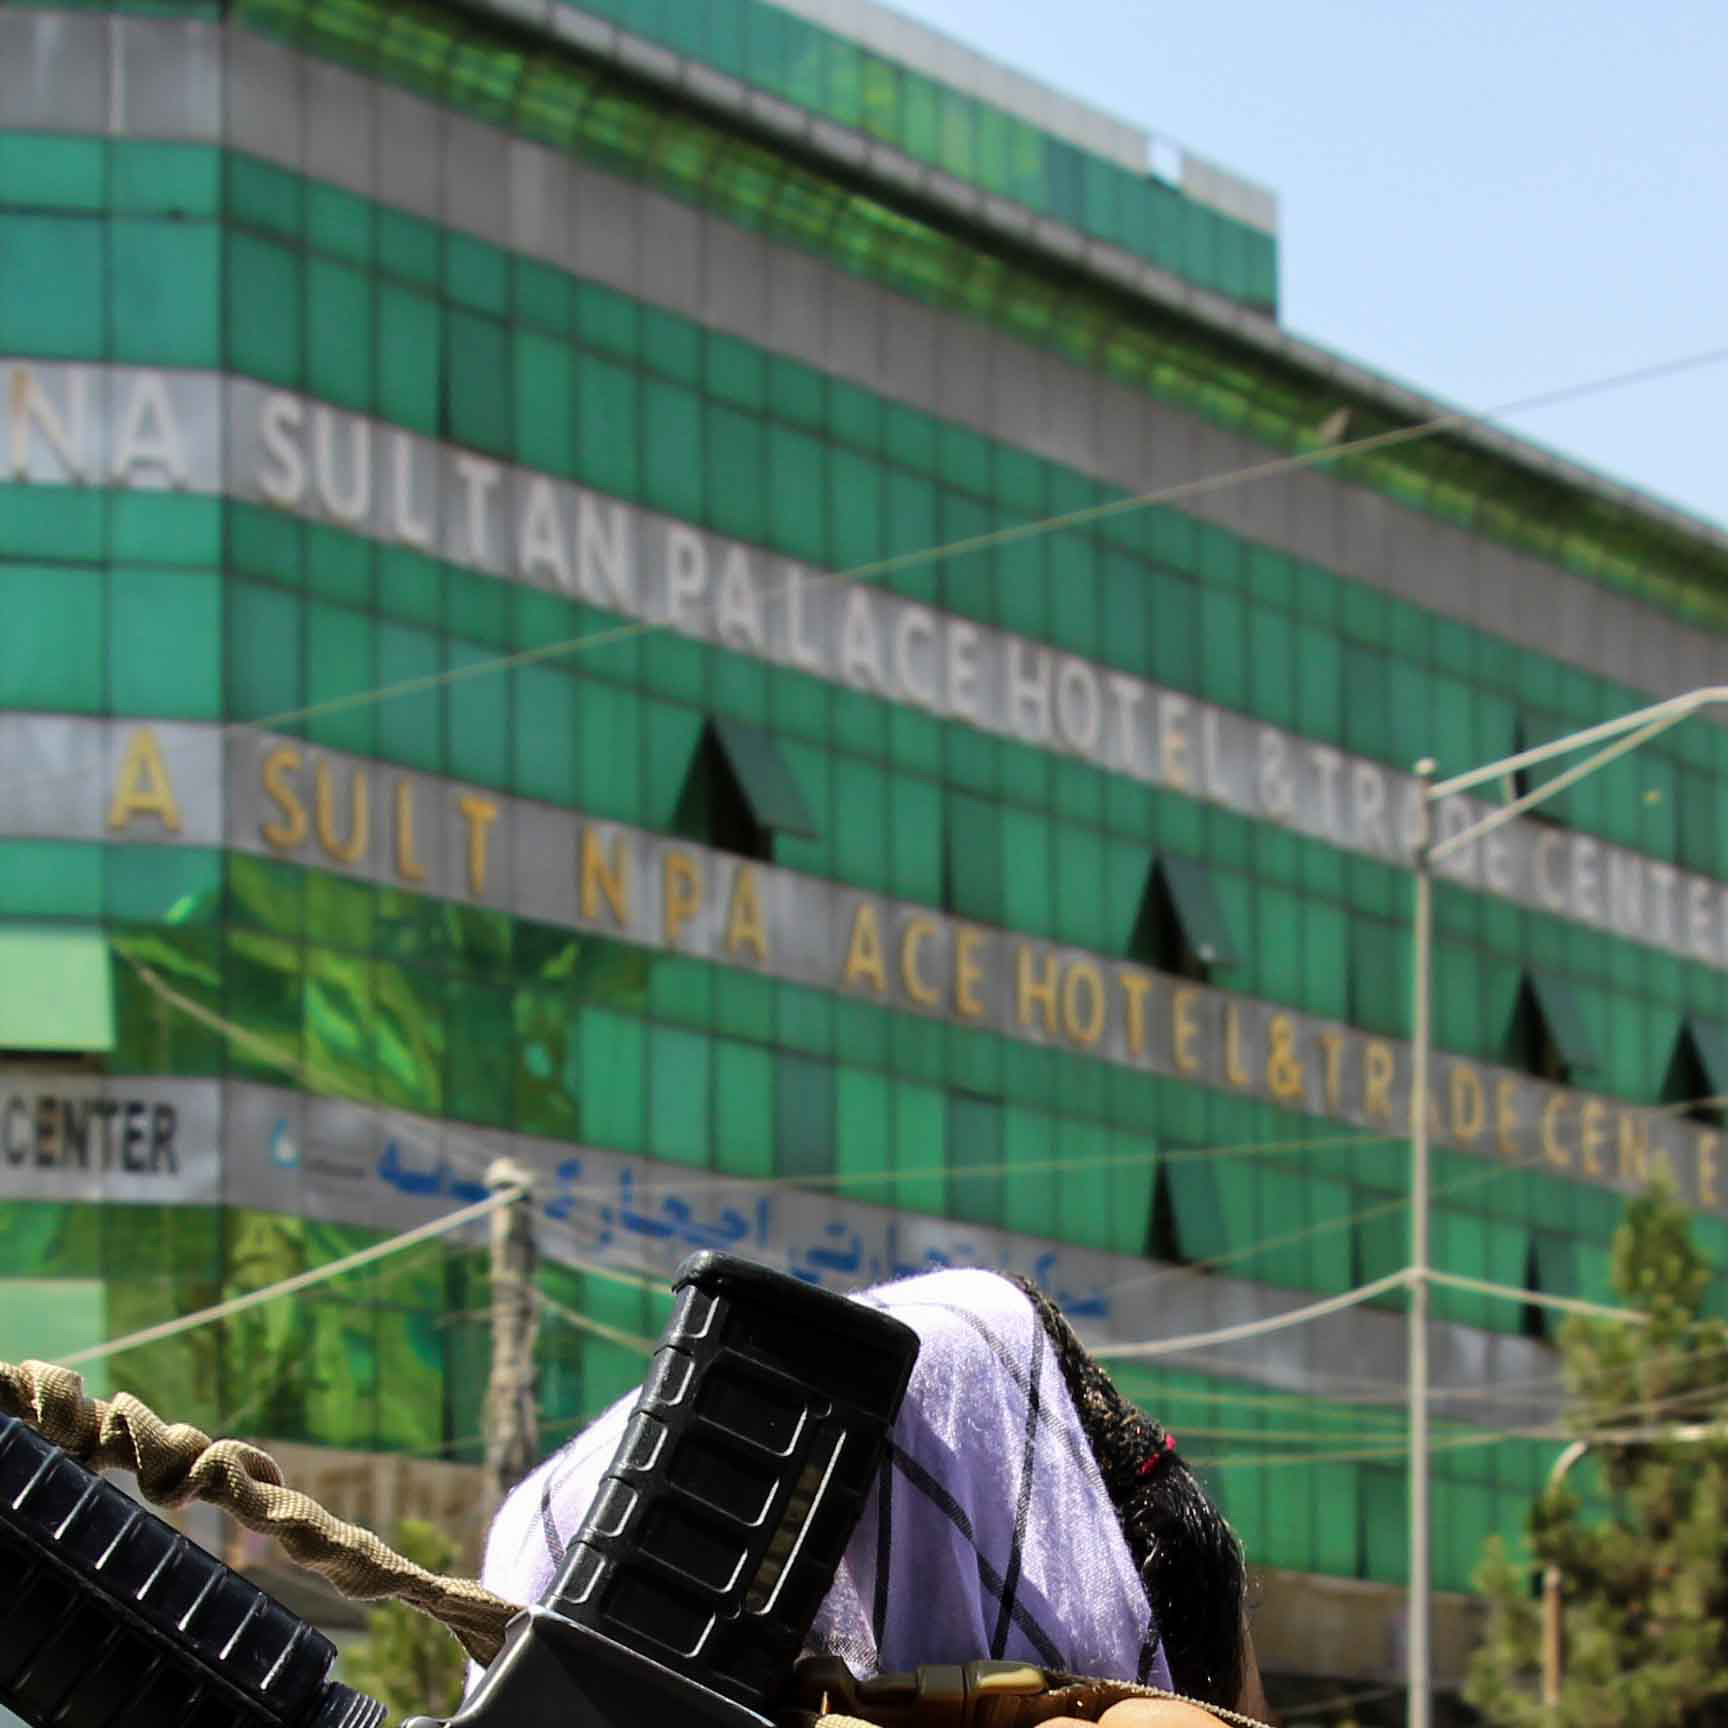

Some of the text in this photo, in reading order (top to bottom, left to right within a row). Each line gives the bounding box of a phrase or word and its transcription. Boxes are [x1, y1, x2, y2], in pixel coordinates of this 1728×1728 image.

[255, 390, 634, 610] SULTAN
[666, 533, 983, 724] PALACE
[1006, 635, 1232, 804] HOTEL
[1015, 943, 1252, 1088] HOTEL
[0, 1094, 181, 1175] CENTER
